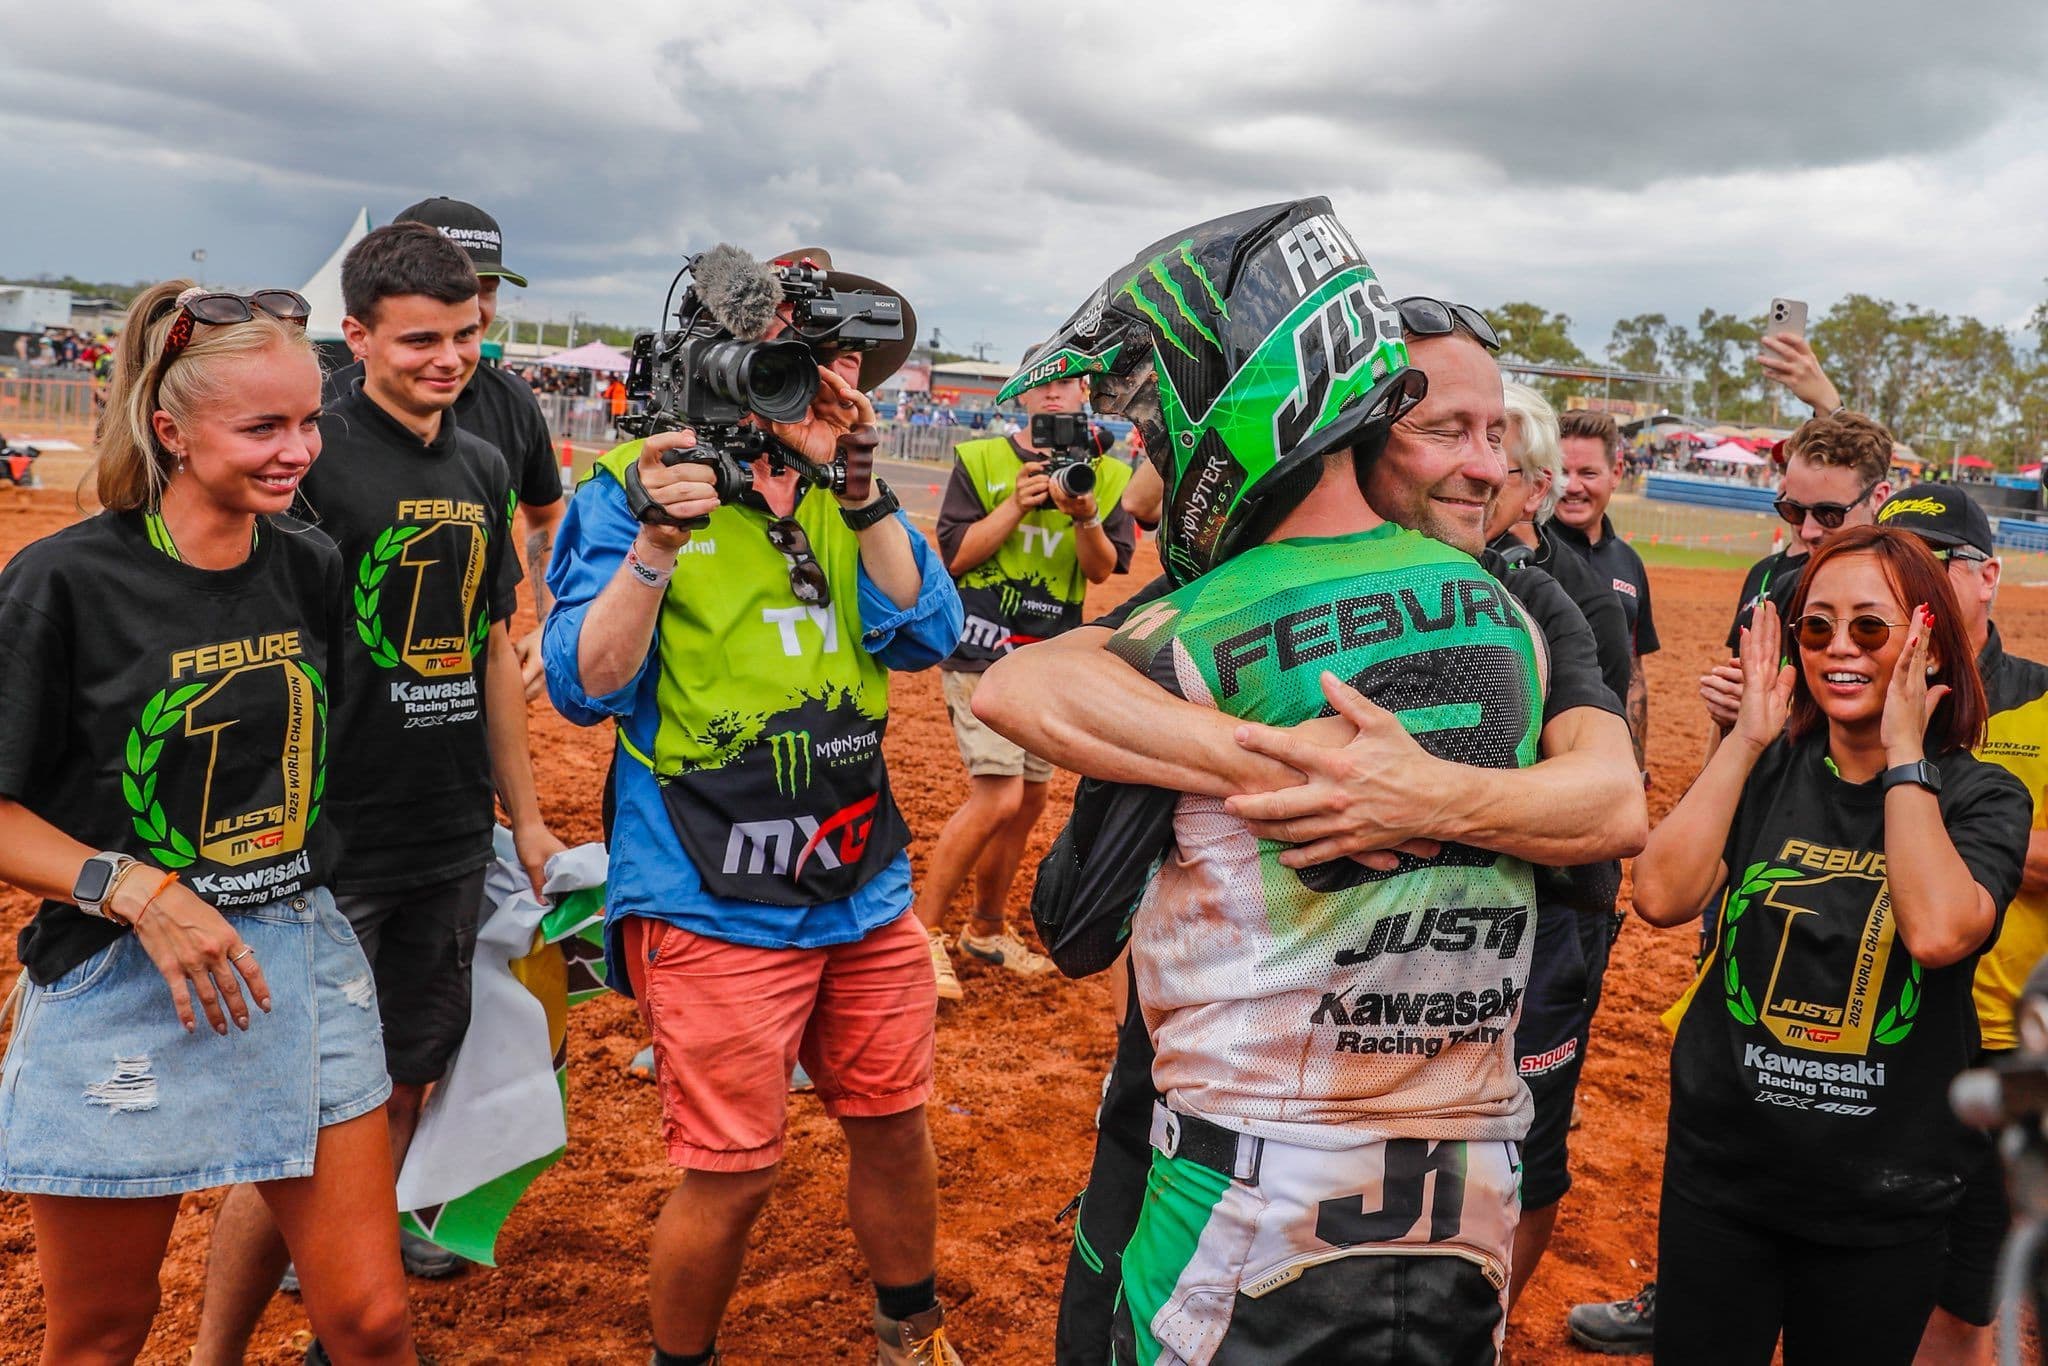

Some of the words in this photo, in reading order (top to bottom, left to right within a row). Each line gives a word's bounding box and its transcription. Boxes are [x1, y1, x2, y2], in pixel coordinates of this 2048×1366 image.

[437, 226, 501, 245] Kawasaki
[456, 239, 481, 249] cing
[481, 241, 498, 251] Team
[1277, 213, 1371, 298] FEBV
[1024, 356, 1067, 386] JUST1
[1273, 279, 1405, 463] JUS
[398, 500, 486, 522] FEBVRE
[1199, 479, 1232, 546] ENERGY
[1018, 523, 1065, 559] TV
[463, 537, 481, 591] CHAMPION
[634, 563, 659, 582] 2025
[1021, 599, 1064, 615] MONSTER
[762, 599, 839, 657] TV
[171, 630, 303, 679] FEBVRE
[411, 637, 466, 651] JUST1
[426, 656, 463, 670] MXGP
[391, 676, 477, 702] Kawasak
[291, 675, 301, 742] CHAMPION
[403, 715, 447, 728] KX
[447, 710, 479, 722] 450
[405, 701, 448, 714] Racing
[449, 697, 475, 710] Team
[816, 731, 878, 758] MONSTER
[831, 750, 874, 768] ENERGY
[289, 745, 300, 792] WORLD
[205, 803, 285, 839] JUST1
[288, 792, 299, 823] 2025
[231, 830, 284, 857] MXGP
[1778, 839, 1887, 876] FEBVR
[191, 850, 312, 894] Kawasaki
[215, 888, 268, 906] Racing
[270, 880, 301, 899] Team
[1333, 905, 1528, 966] JUST1
[1865, 891, 1891, 953] CHAMPION
[1854, 953, 1876, 998] WORLD
[1310, 976, 1525, 1027] Kawasak
[1770, 998, 1844, 1025] JUST1
[1848, 998, 1863, 1029] 2025
[1335, 1030, 1444, 1060] Racing
[1786, 1024, 1841, 1043] MXGP
[1519, 1037, 1577, 1072] SHOWA
[1743, 1043, 1886, 1087] Kawasaki
[1757, 1071, 1817, 1095] Racing
[1819, 1081, 1868, 1100] Team
[1754, 1090, 1815, 1110] KX
[1814, 1101, 1877, 1116] 450
